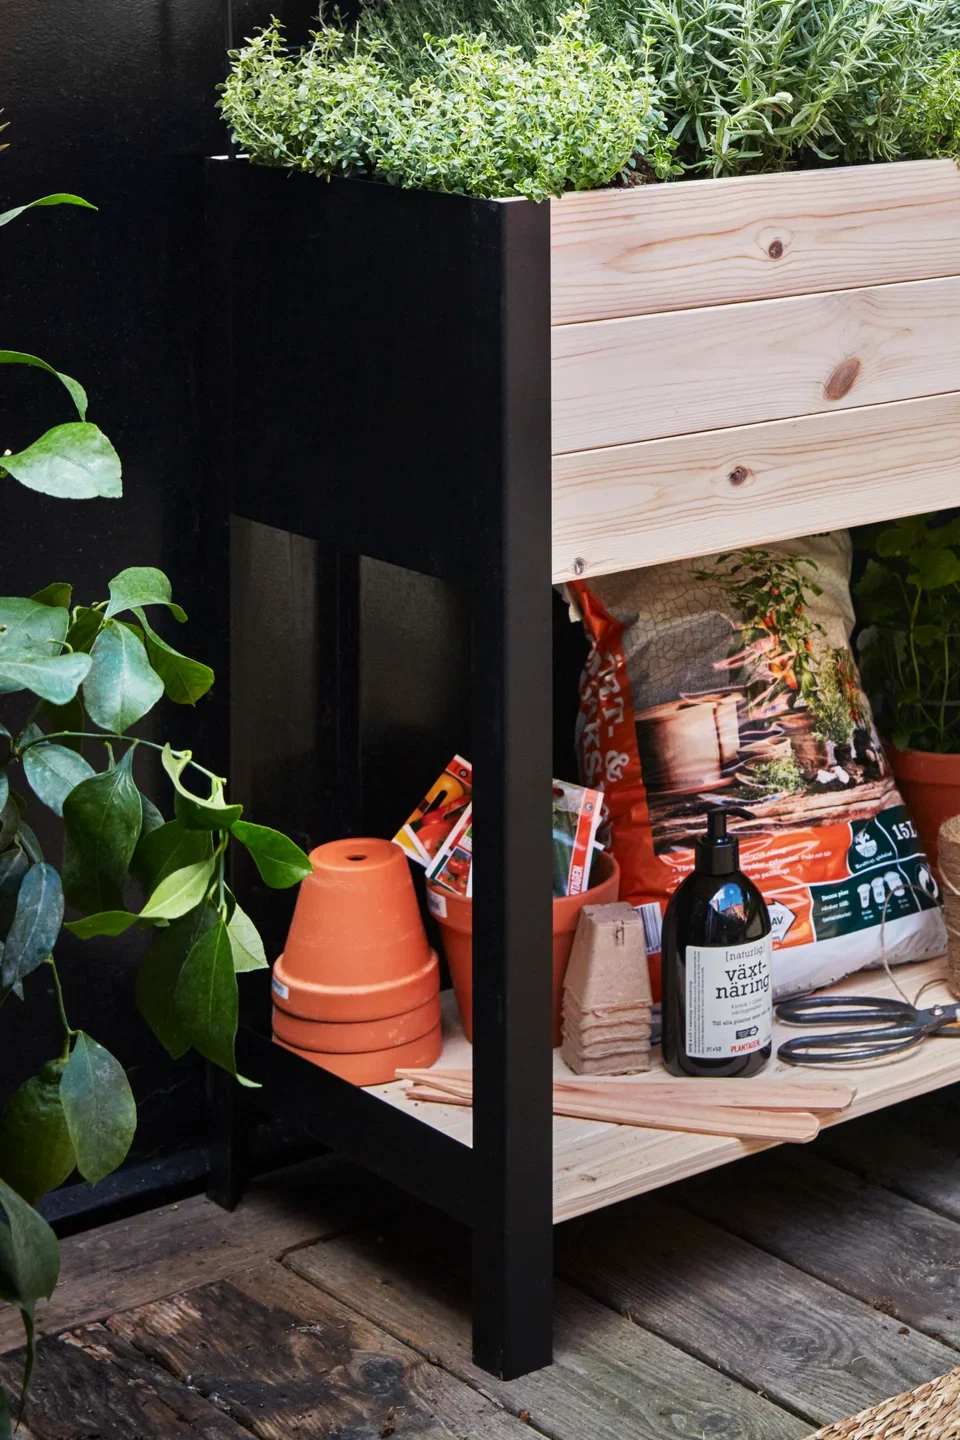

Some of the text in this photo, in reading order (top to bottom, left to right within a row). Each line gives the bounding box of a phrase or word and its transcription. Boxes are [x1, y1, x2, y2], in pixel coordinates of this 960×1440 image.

[725, 960, 767, 981] växt-
[716, 973, 770, 999] näring
[730, 1039, 761, 1053] PLANTAGEN
